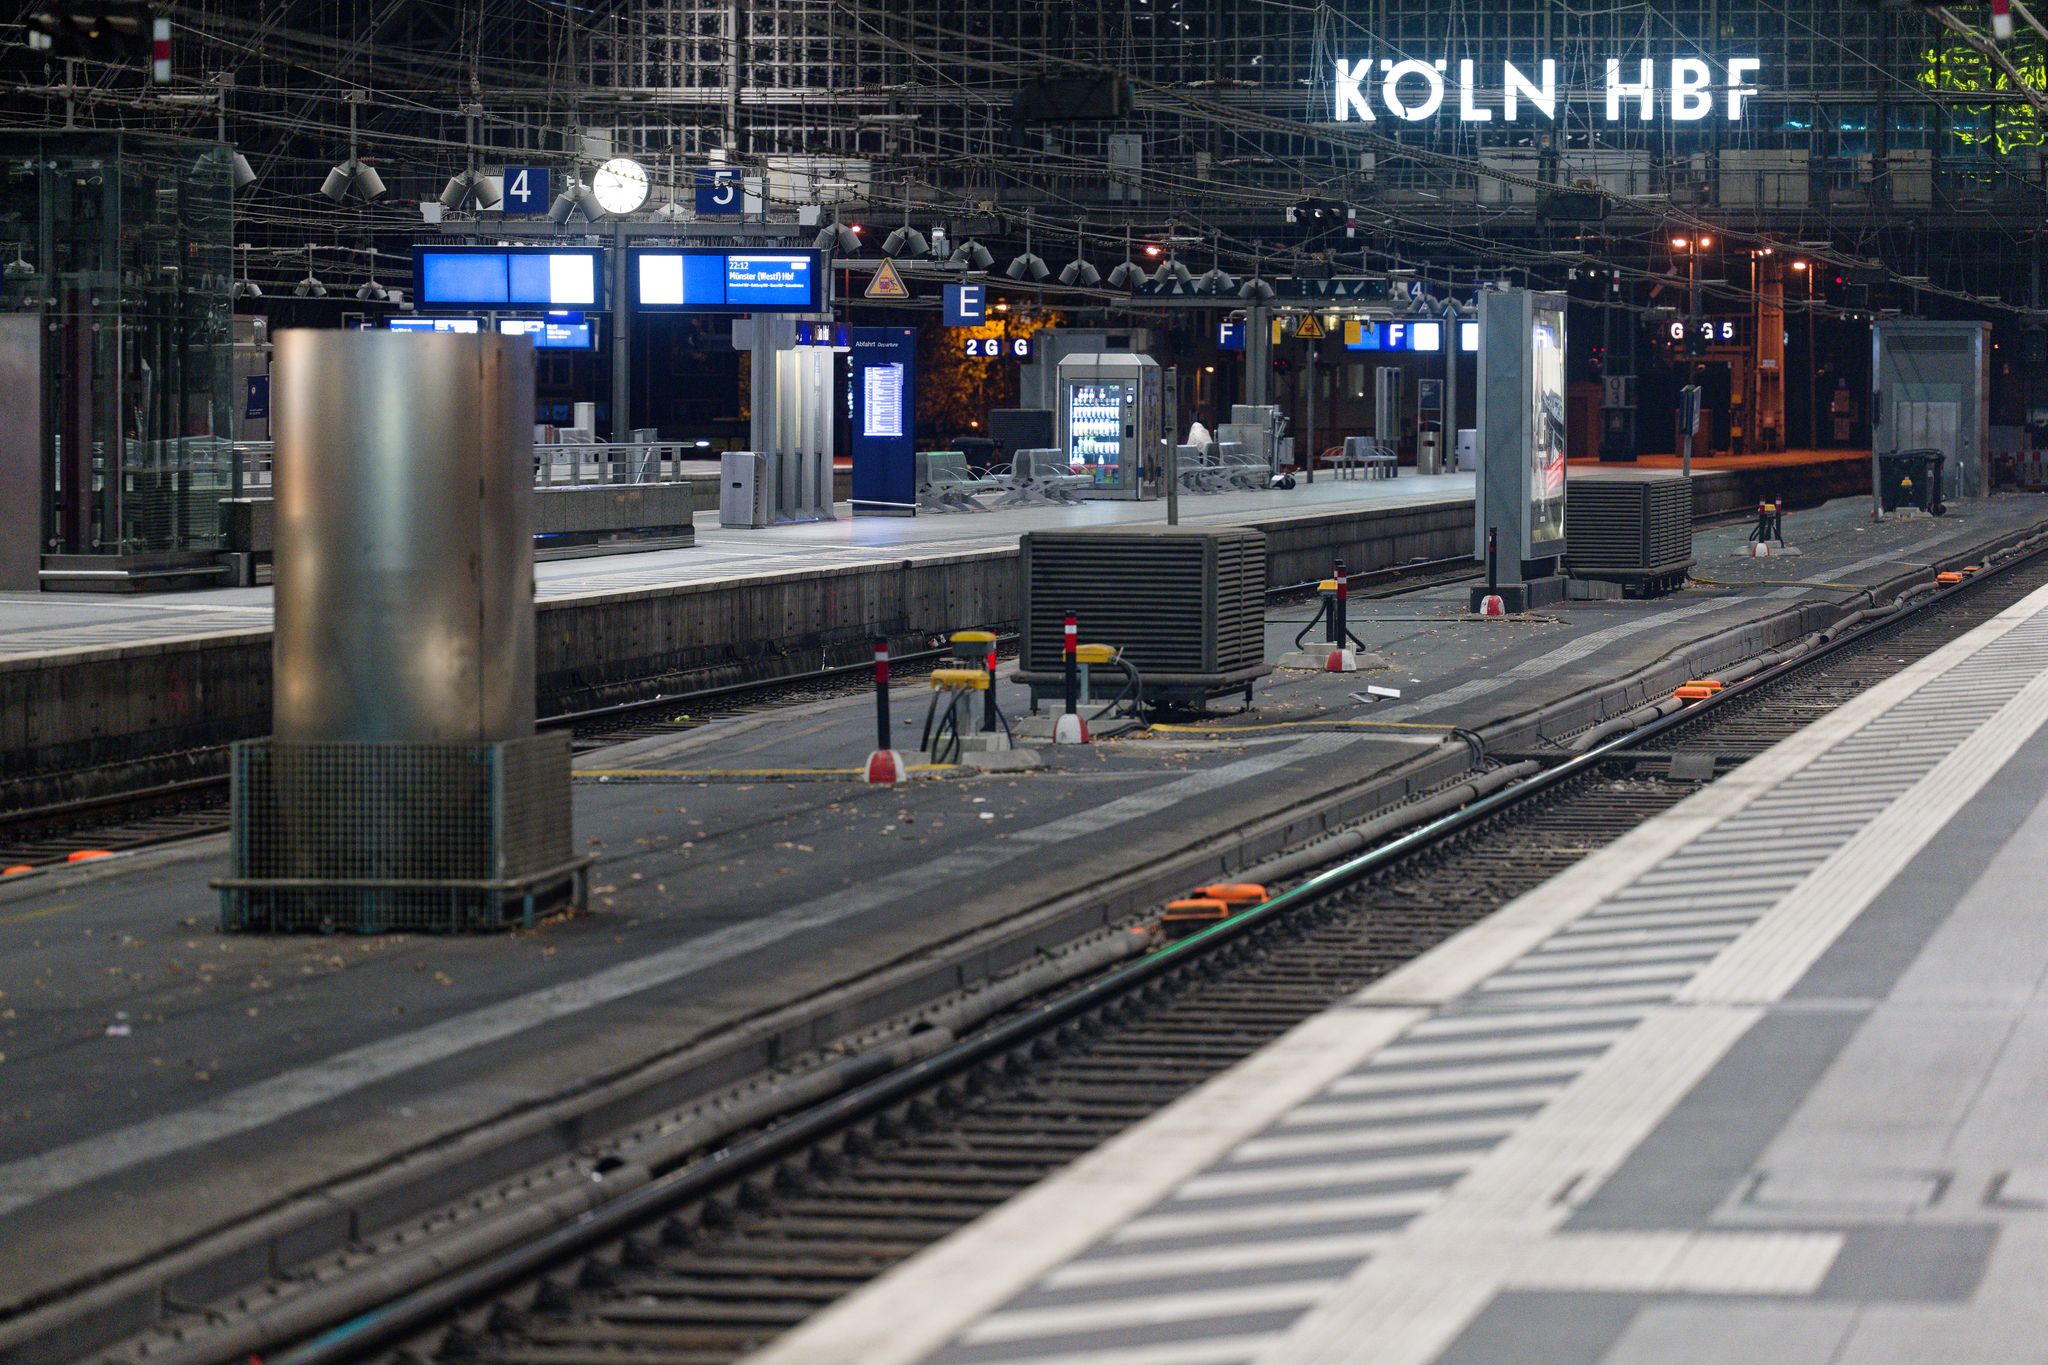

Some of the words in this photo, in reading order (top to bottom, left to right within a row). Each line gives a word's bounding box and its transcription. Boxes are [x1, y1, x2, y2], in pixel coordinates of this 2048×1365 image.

[1335, 57, 1556, 121] KÖLN
[1606, 58, 1761, 121] HBF
[509, 169, 532, 203] 4
[713, 171, 734, 205] 5
[729, 261, 749, 270] 22:12
[729, 272, 756, 281] Münster
[782, 271, 794, 281] Hbf
[1411, 281, 1422, 297] 4
[960, 286, 979, 317] E
[1220, 323, 1233, 344] F
[1389, 323, 1404, 347] F
[1671, 323, 1684, 339] G
[1722, 322, 1733, 338] 5
[966, 338, 977, 355] 2
[985, 338, 998, 356] G
[1014, 338, 1028, 356] G
